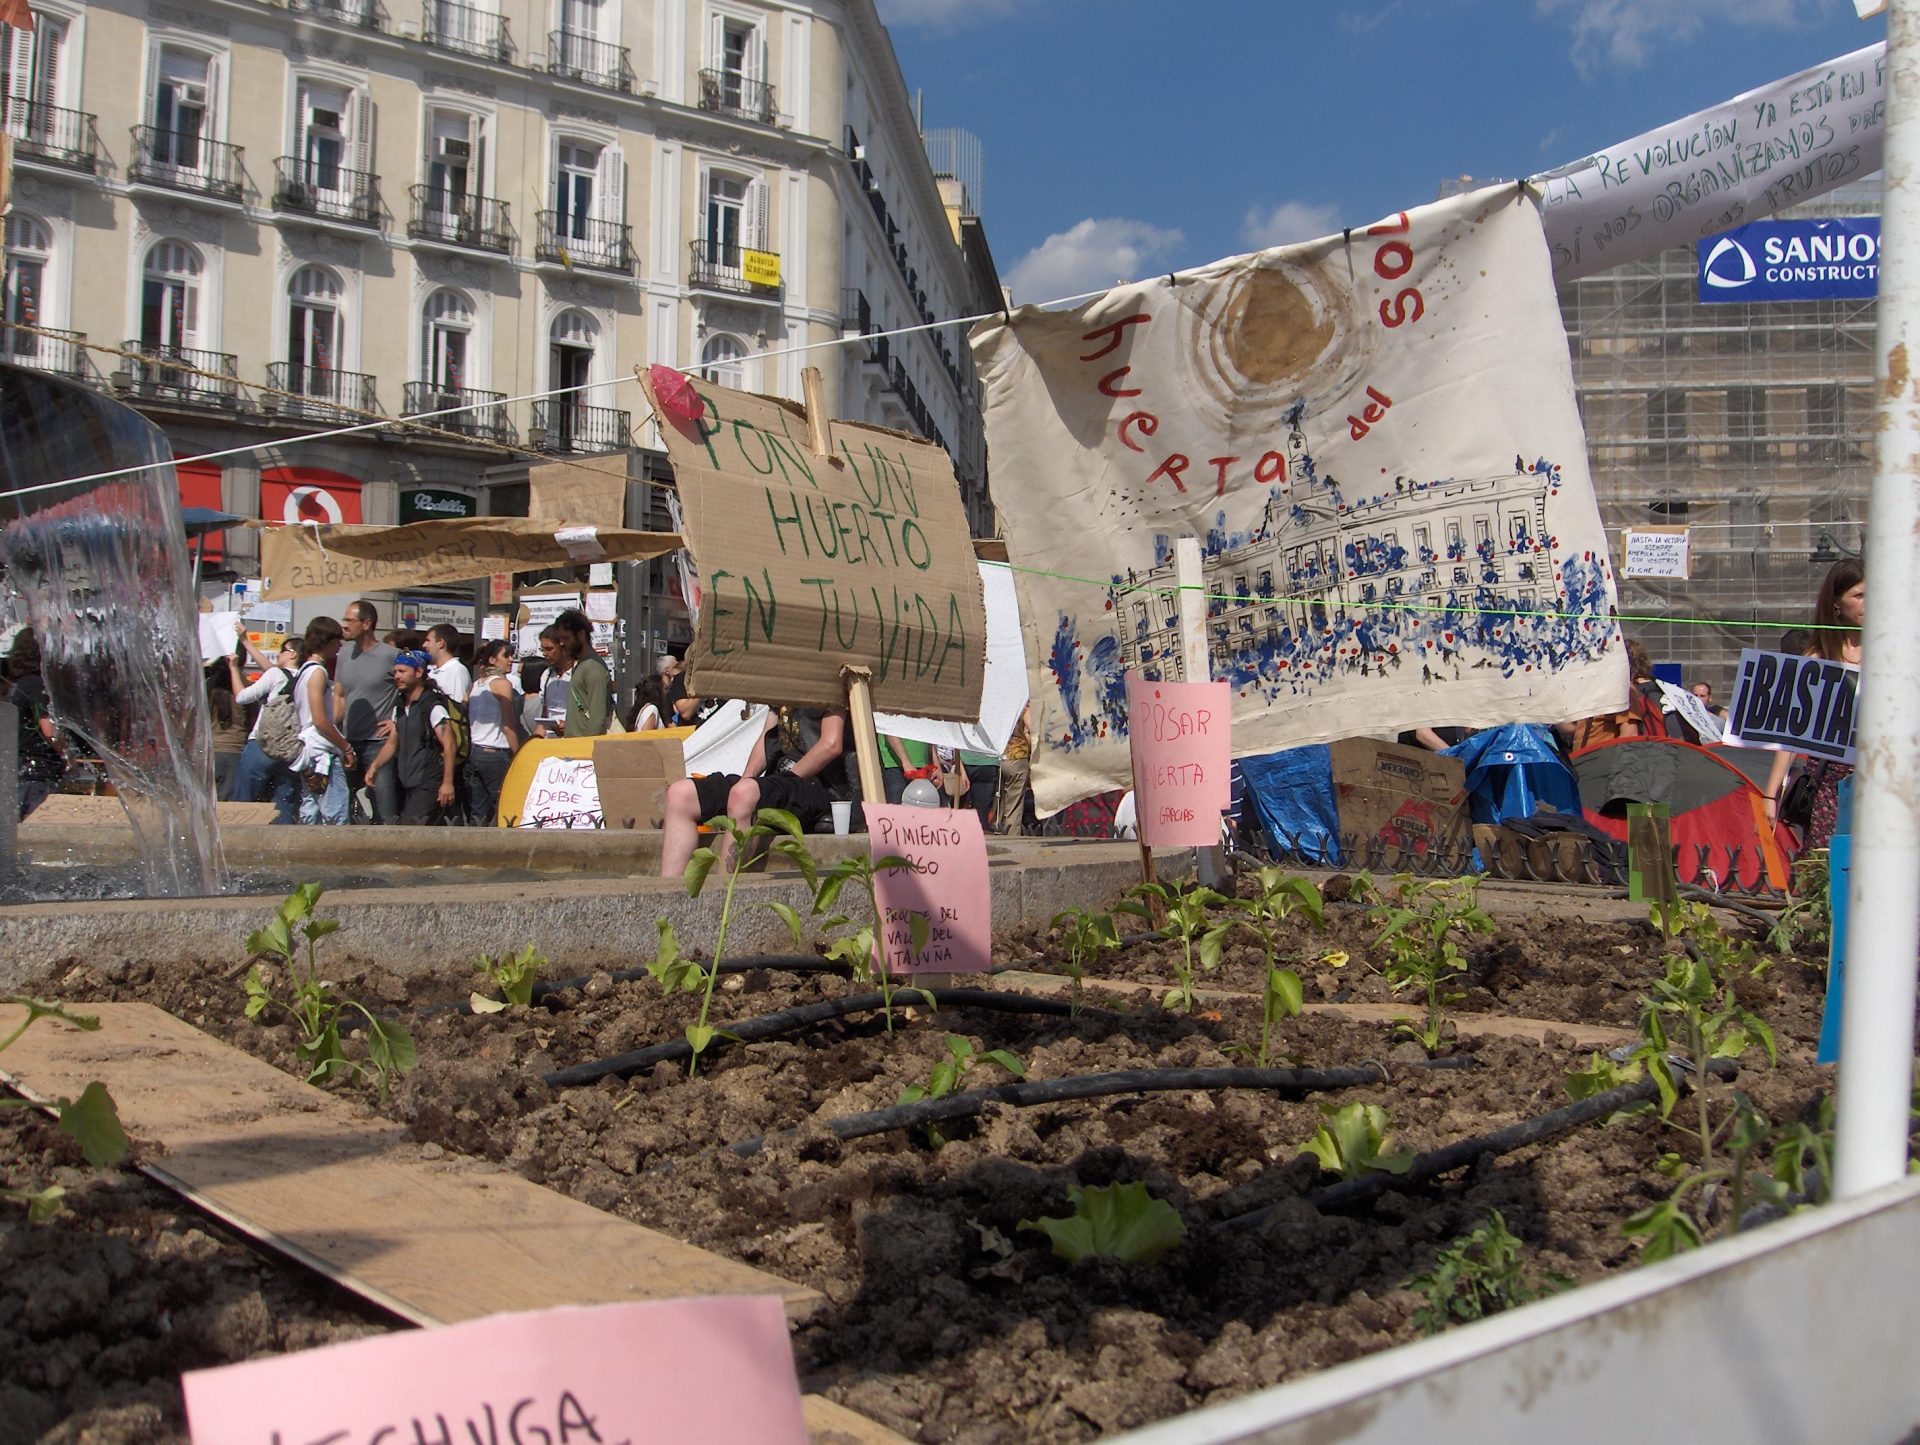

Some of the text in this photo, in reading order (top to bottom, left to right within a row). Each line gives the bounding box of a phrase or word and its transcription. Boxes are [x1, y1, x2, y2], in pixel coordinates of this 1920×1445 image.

[1545, 177, 1582, 207] LA
[1755, 102, 1776, 129] YA
[1840, 72, 1864, 100] EN
[1594, 206, 1642, 250] NOS
[1653, 115, 1834, 222] ORGANIZAMOS
[1762, 144, 1860, 210] FRUTOS
[1765, 265, 1880, 283] CONSTRUCT
[694, 394, 920, 519] PON UN
[766, 486, 931, 571] HUERTO
[710, 569, 777, 656] EN
[800, 577, 860, 652] TU
[548, 768, 575, 785] UNA
[536, 789, 582, 806] DEBE
[1160, 806, 1195, 825] GRACIAS
[878, 817, 961, 847] PIMIENTO
[939, 906, 958, 923] DEL
[887, 928, 953, 945] VALL DEL
